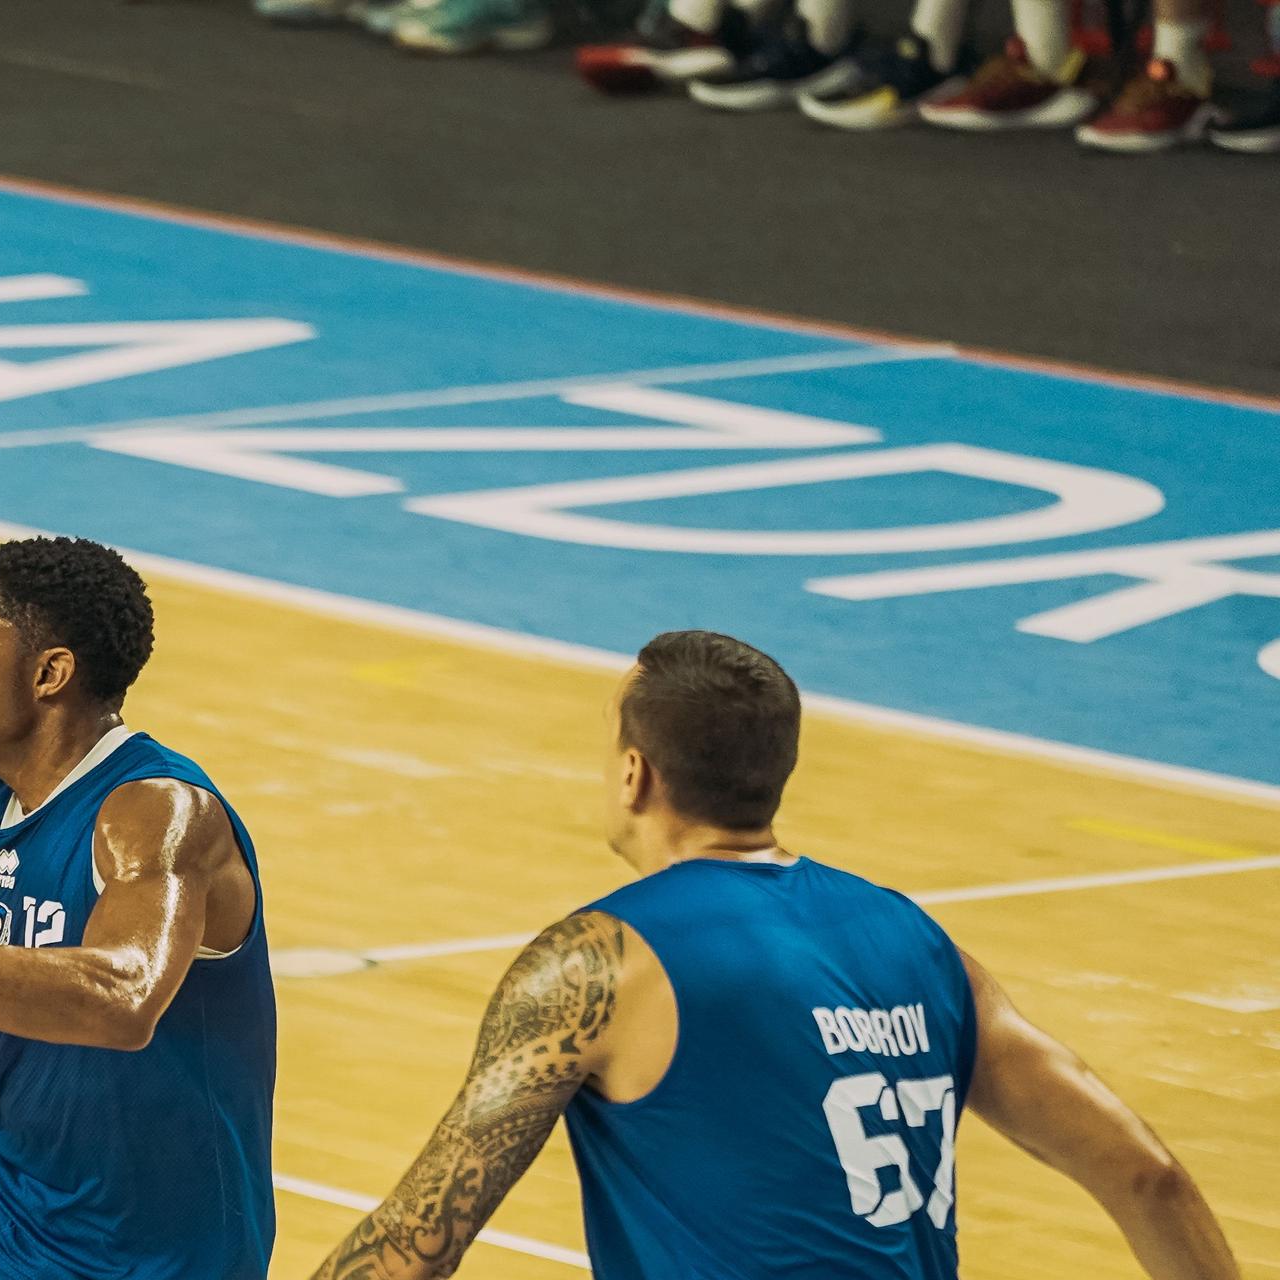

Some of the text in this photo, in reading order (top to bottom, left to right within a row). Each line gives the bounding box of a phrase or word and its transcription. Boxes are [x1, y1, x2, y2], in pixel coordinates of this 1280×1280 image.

[86, 385, 1280, 680] ZDR
[23, 896, 66, 949] 12
[822, 1071, 956, 1229] 67
